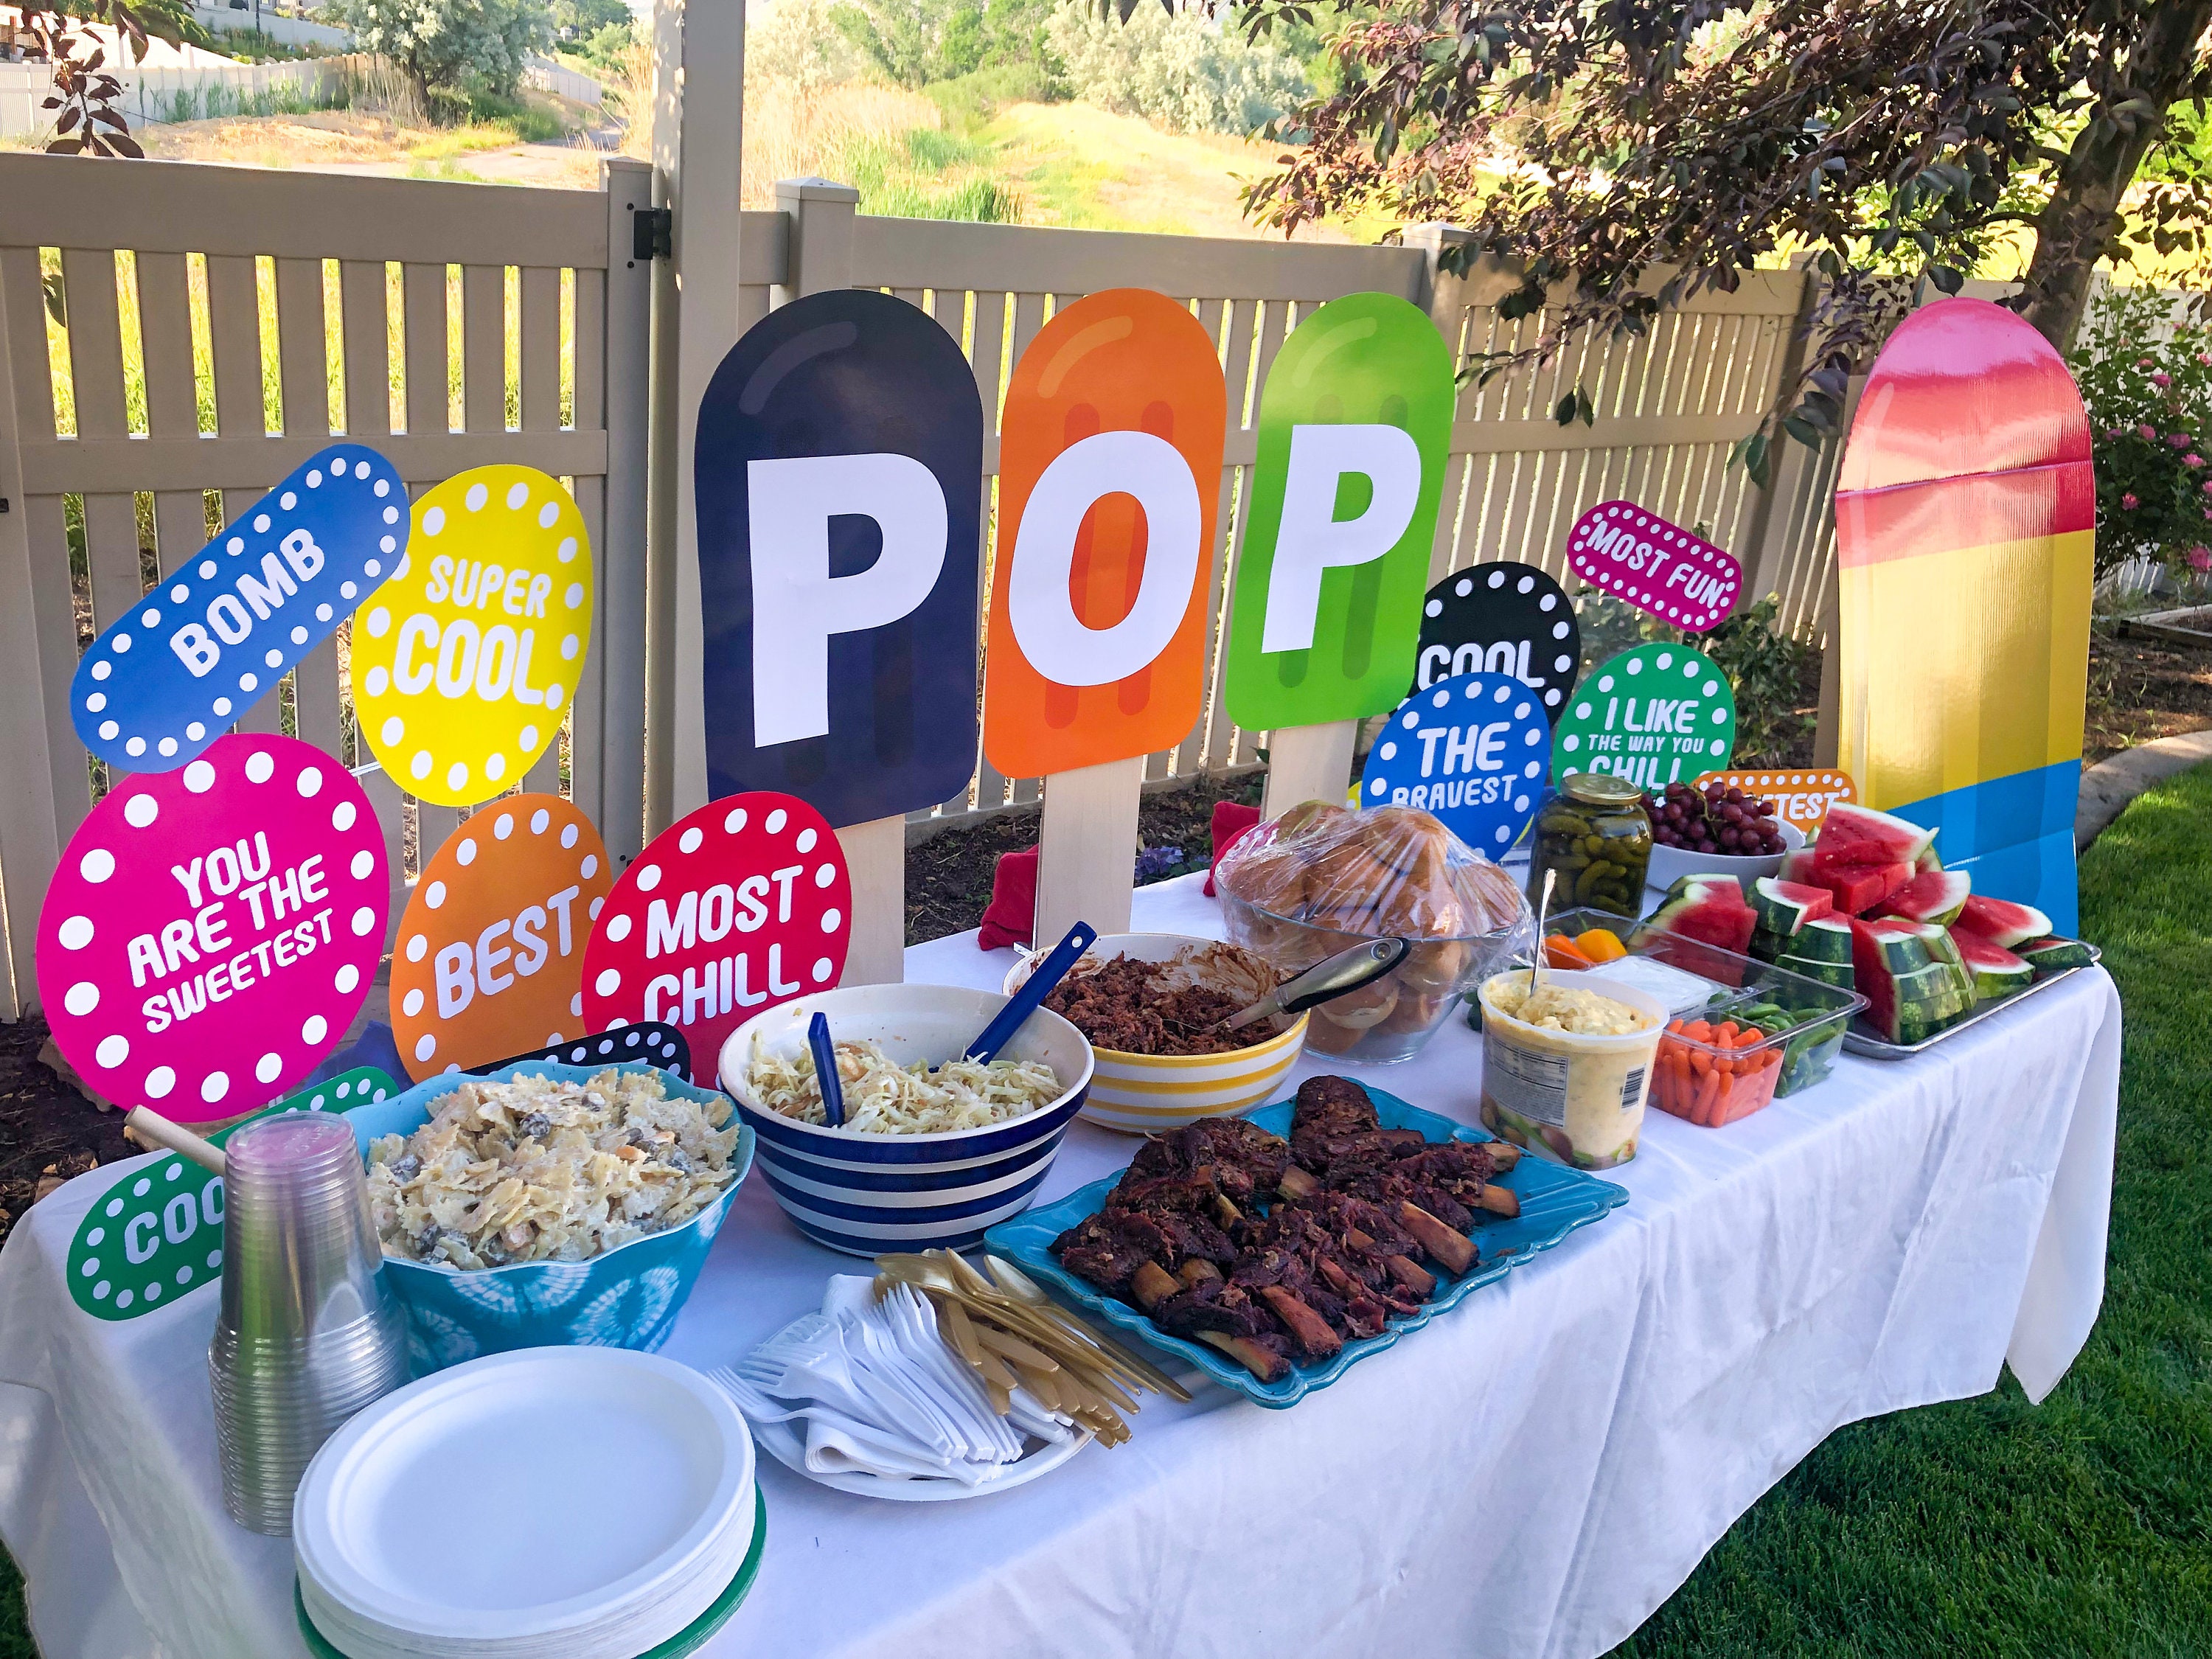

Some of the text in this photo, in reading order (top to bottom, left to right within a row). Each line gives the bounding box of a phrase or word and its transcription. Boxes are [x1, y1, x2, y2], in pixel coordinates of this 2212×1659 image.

[170, 529, 325, 678] BOMB
[425, 555, 552, 619] SUPER
[1586, 521, 1725, 609] MOST FUN
[393, 613, 545, 706] COOL
[1418, 640, 1545, 691] COOL
[1416, 722, 1511, 778] THE
[1588, 734, 1705, 754] THE WAY YOU
[1604, 697, 1699, 734] I LIKE
[1392, 774, 1517, 811] BRAVEST
[171, 831, 271, 908] YOU
[127, 854, 329, 987] ARE THE
[434, 885, 580, 1020] BEST
[646, 865, 803, 959] MOST
[142, 908, 333, 1034] SWEETEST
[644, 943, 800, 1026] CHILL
